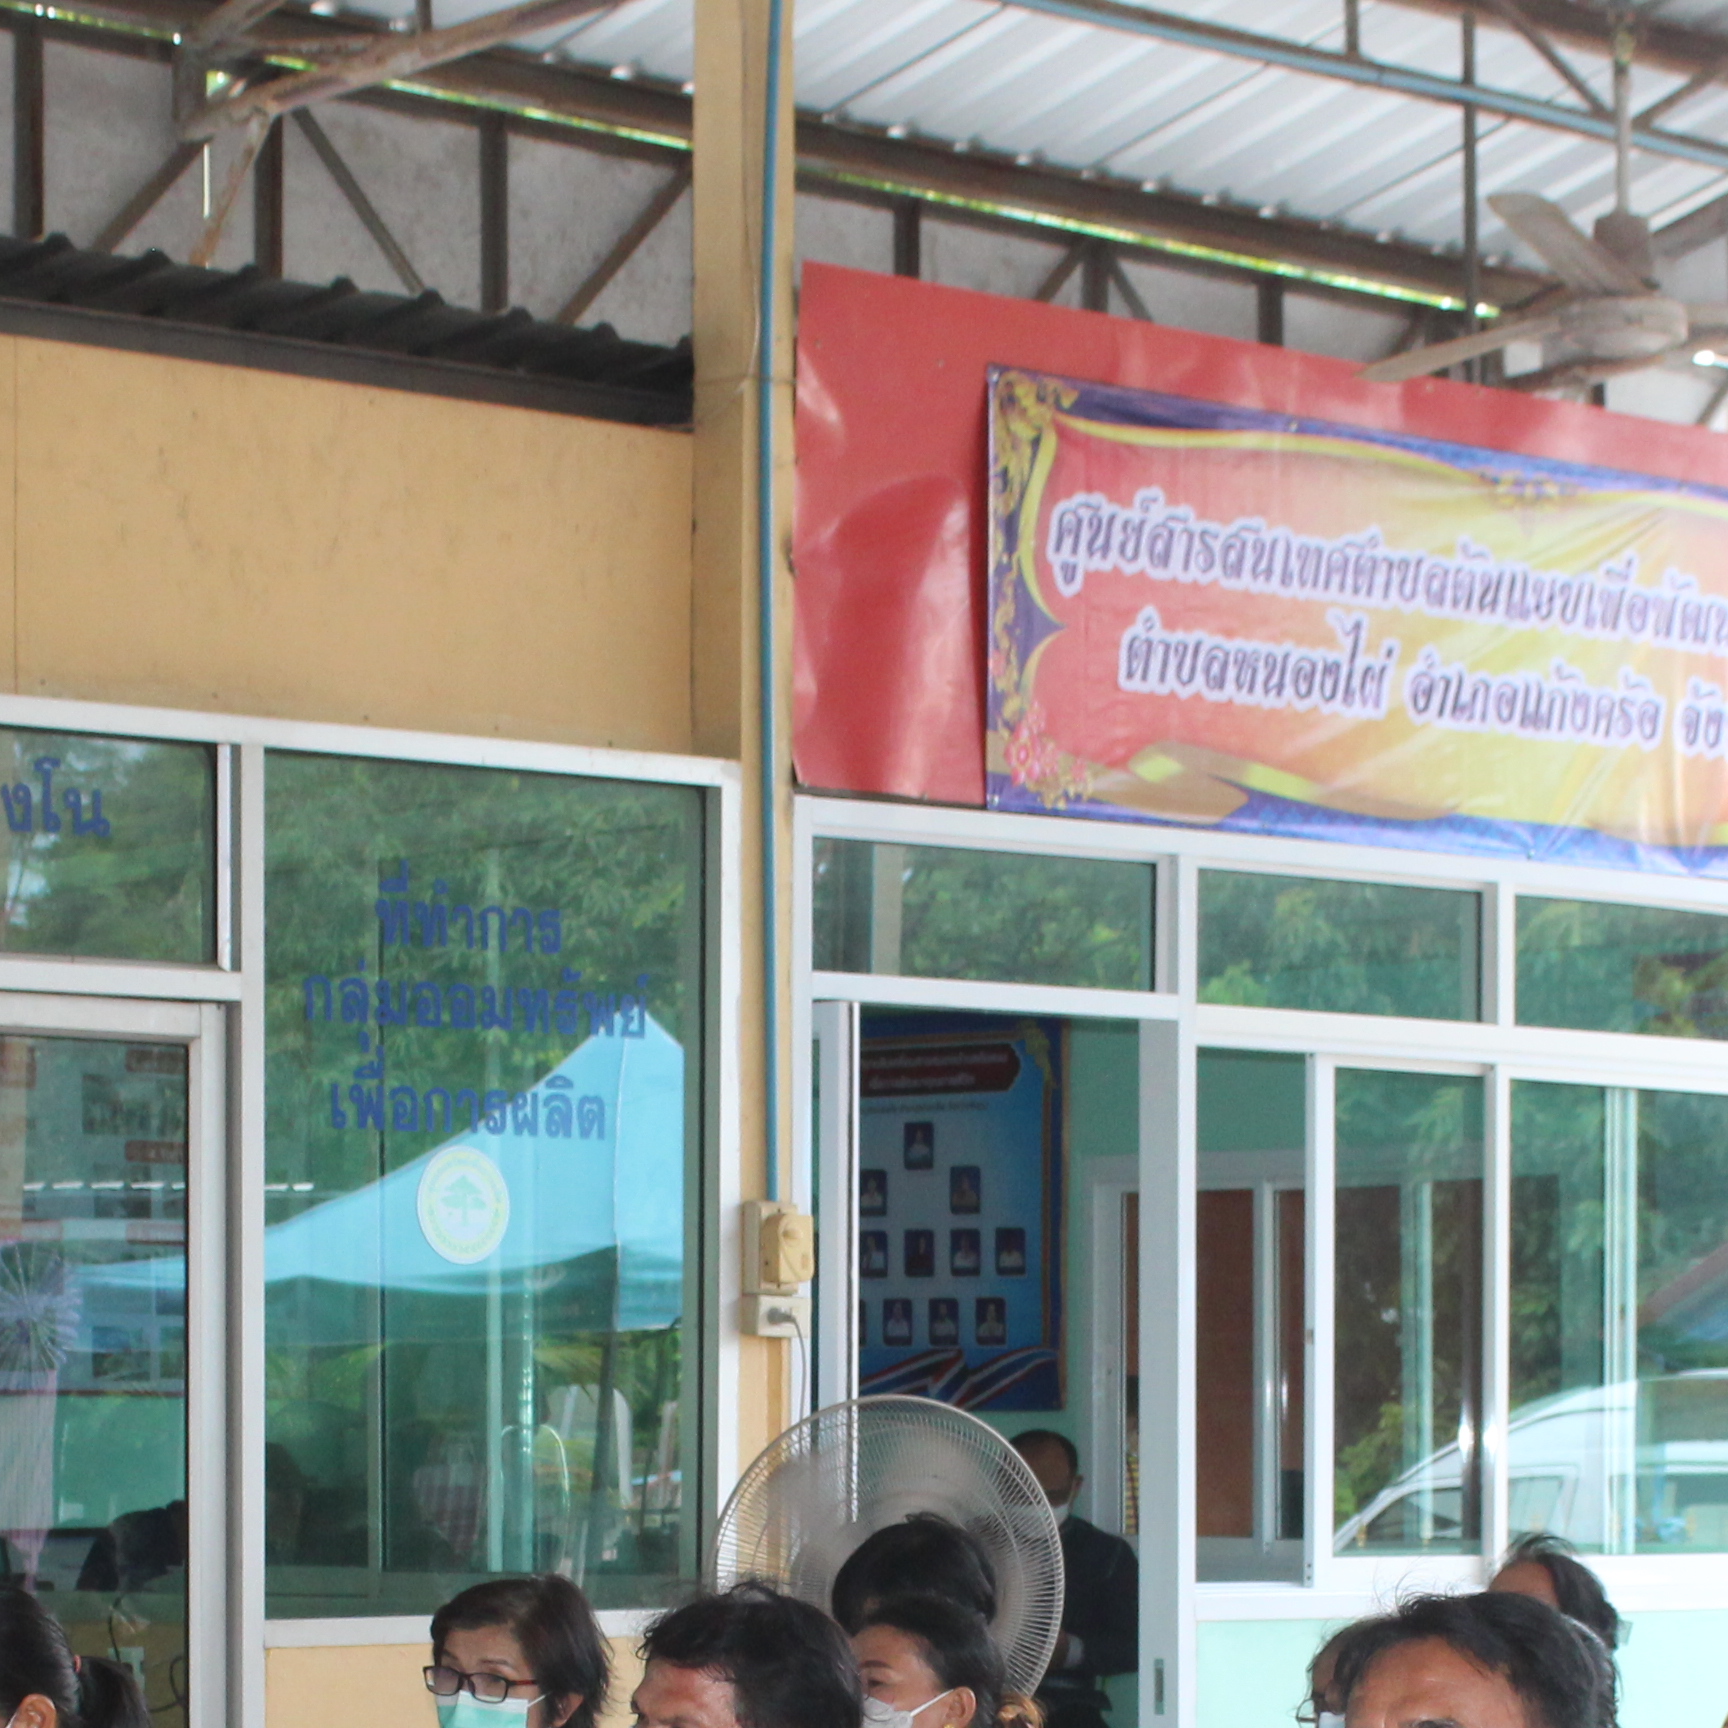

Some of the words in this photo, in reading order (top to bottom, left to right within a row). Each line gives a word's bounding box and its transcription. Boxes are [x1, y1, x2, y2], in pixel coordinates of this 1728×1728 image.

[1121, 608, 1398, 718] ตำบลหนองไผ่
[1408, 645, 1664, 750] อำเภอแก้งคร้อ
[376, 858, 564, 954] ที่ทำการ
[303, 958, 649, 1053] กลุ่มออมทรัพย์
[330, 1045, 607, 1141] เพื่อการผลิต
